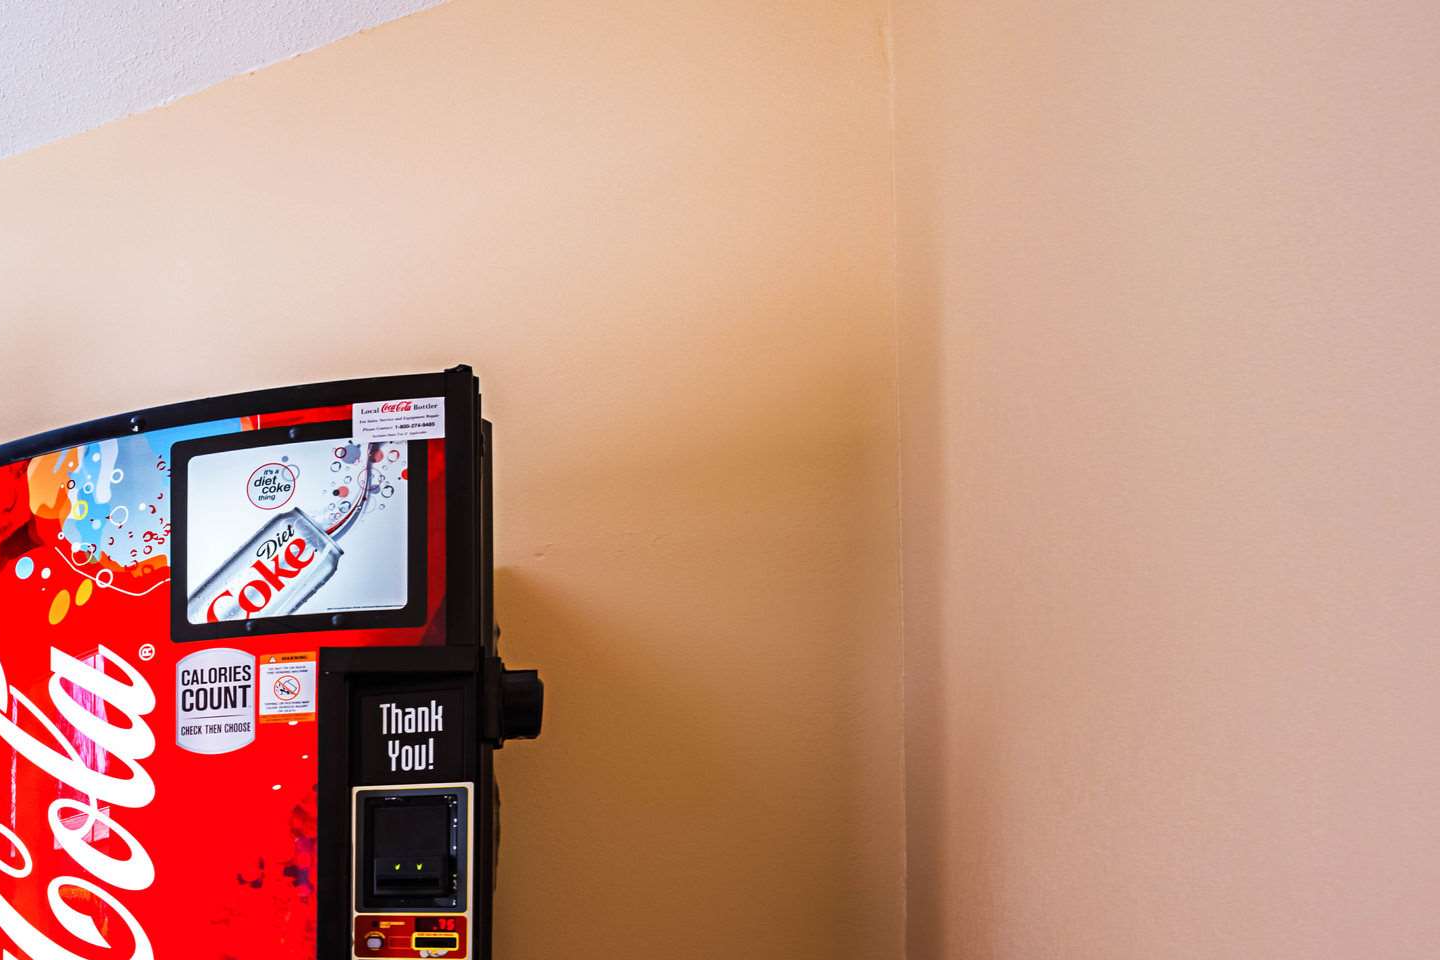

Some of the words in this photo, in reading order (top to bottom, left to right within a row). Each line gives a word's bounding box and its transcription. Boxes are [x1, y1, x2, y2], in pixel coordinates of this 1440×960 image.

[381, 401, 413, 413] Coca-Cola
[413, 403, 438, 411] Bottler
[254, 475, 277, 487] diet
[262, 483, 291, 494] coke
[256, 524, 295, 560] Diet
[206, 538, 315, 623] Coke
[181, 665, 252, 686] CALORIES
[181, 685, 252, 712] COUNT
[181, 725, 202, 736] CHECK
[205, 724, 222, 734] THEN
[224, 722, 252, 733] CHOOSE
[379, 700, 443, 735] Thank
[388, 737, 435, 772] You!
